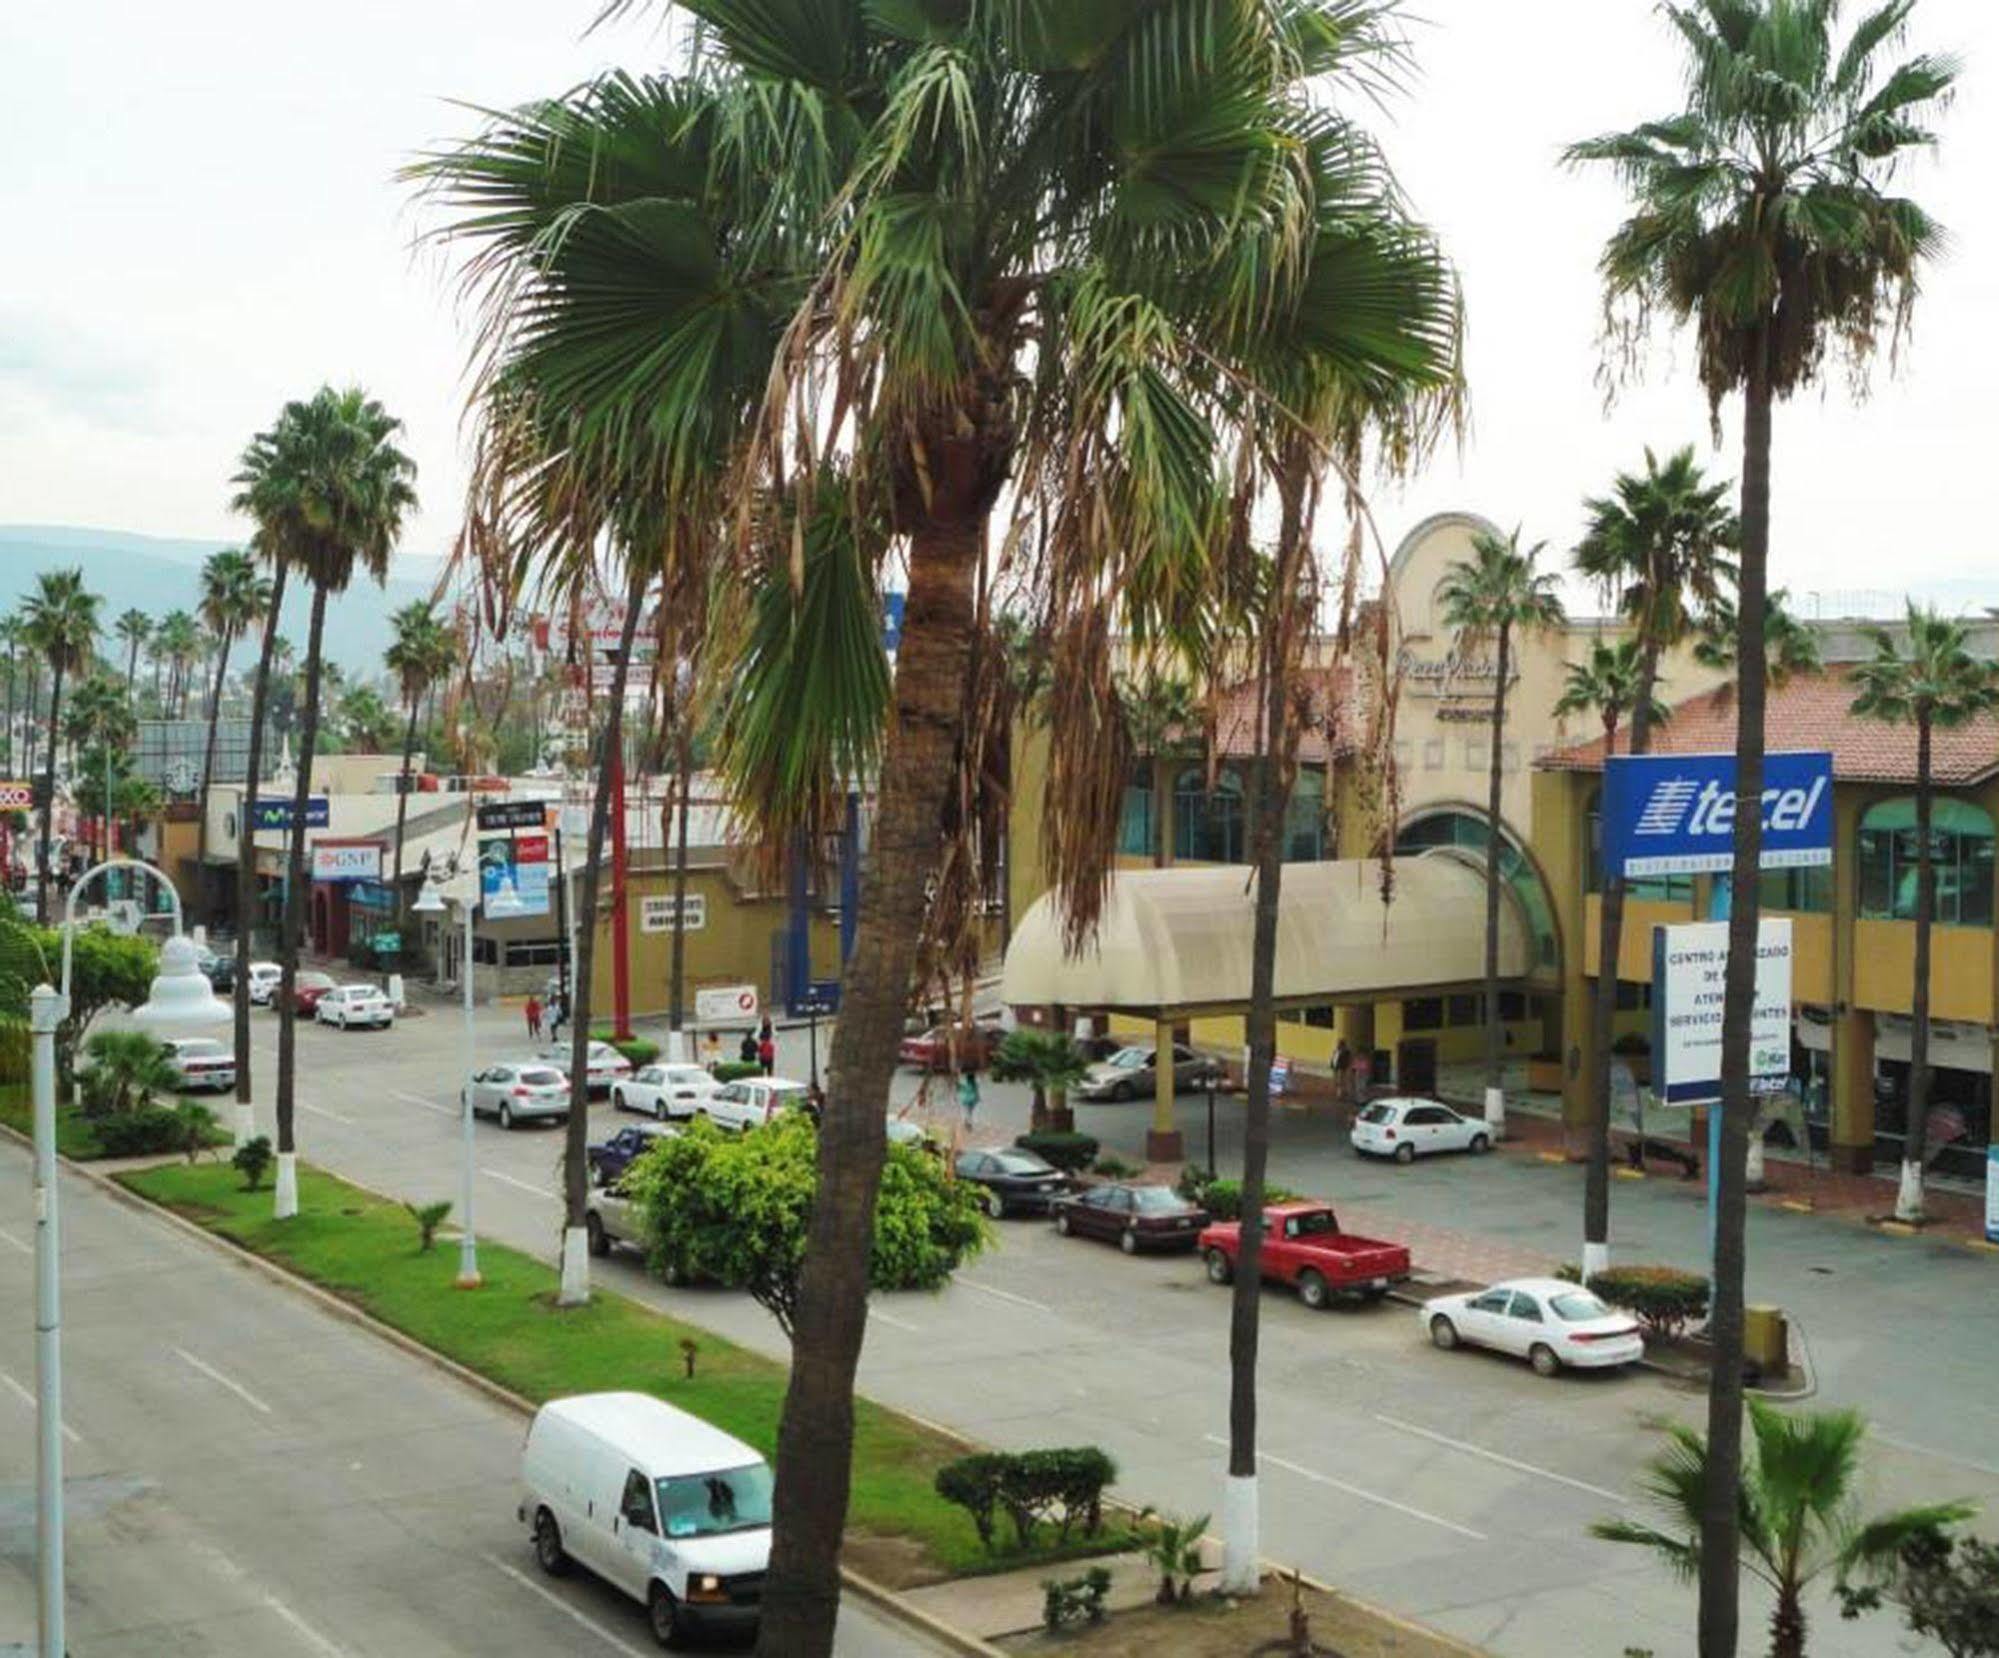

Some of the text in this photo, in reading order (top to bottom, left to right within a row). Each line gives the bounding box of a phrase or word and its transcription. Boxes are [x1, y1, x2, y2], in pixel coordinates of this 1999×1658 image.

[1689, 775, 1827, 835] tecel
[335, 852, 371, 867] GNP
[1669, 950, 1714, 966] CENTRO
[1704, 970, 1718, 981] DE
